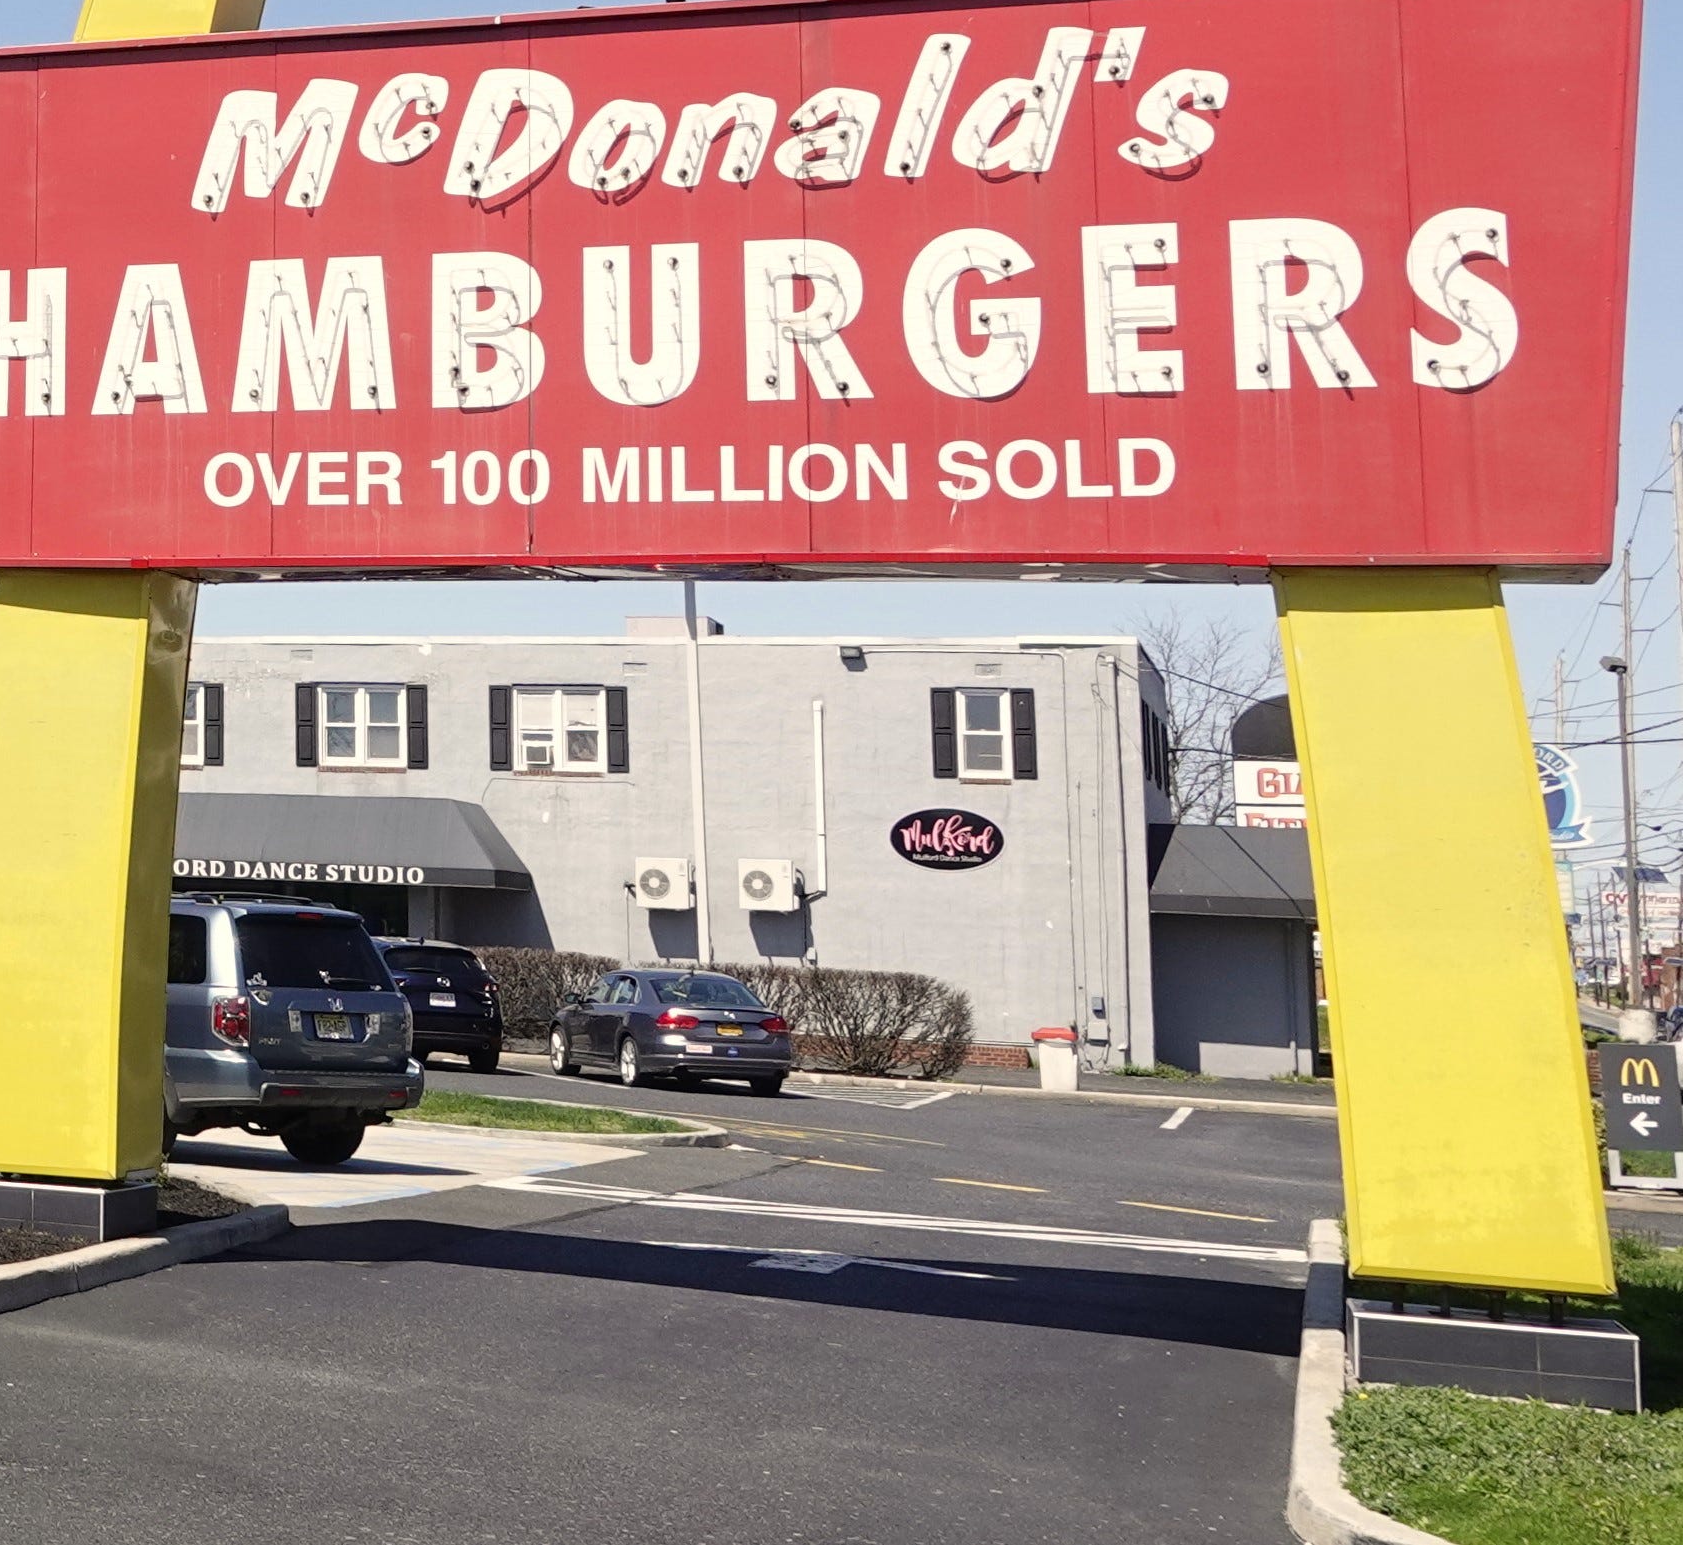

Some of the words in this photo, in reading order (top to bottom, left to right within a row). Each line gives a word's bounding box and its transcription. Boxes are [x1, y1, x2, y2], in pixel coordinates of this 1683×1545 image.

[191, 26, 1230, 214] McDonald's
[203, 450, 403, 508] OVER
[430, 447, 552, 507] 100
[581, 441, 910, 504] MILLION
[937, 436, 1177, 501] SOLD
[899, 814, 994, 854] Mulford
[234, 861, 318, 881] DANCE
[325, 864, 424, 885] STUDIO
[1622, 1092, 1662, 1105] Enter
